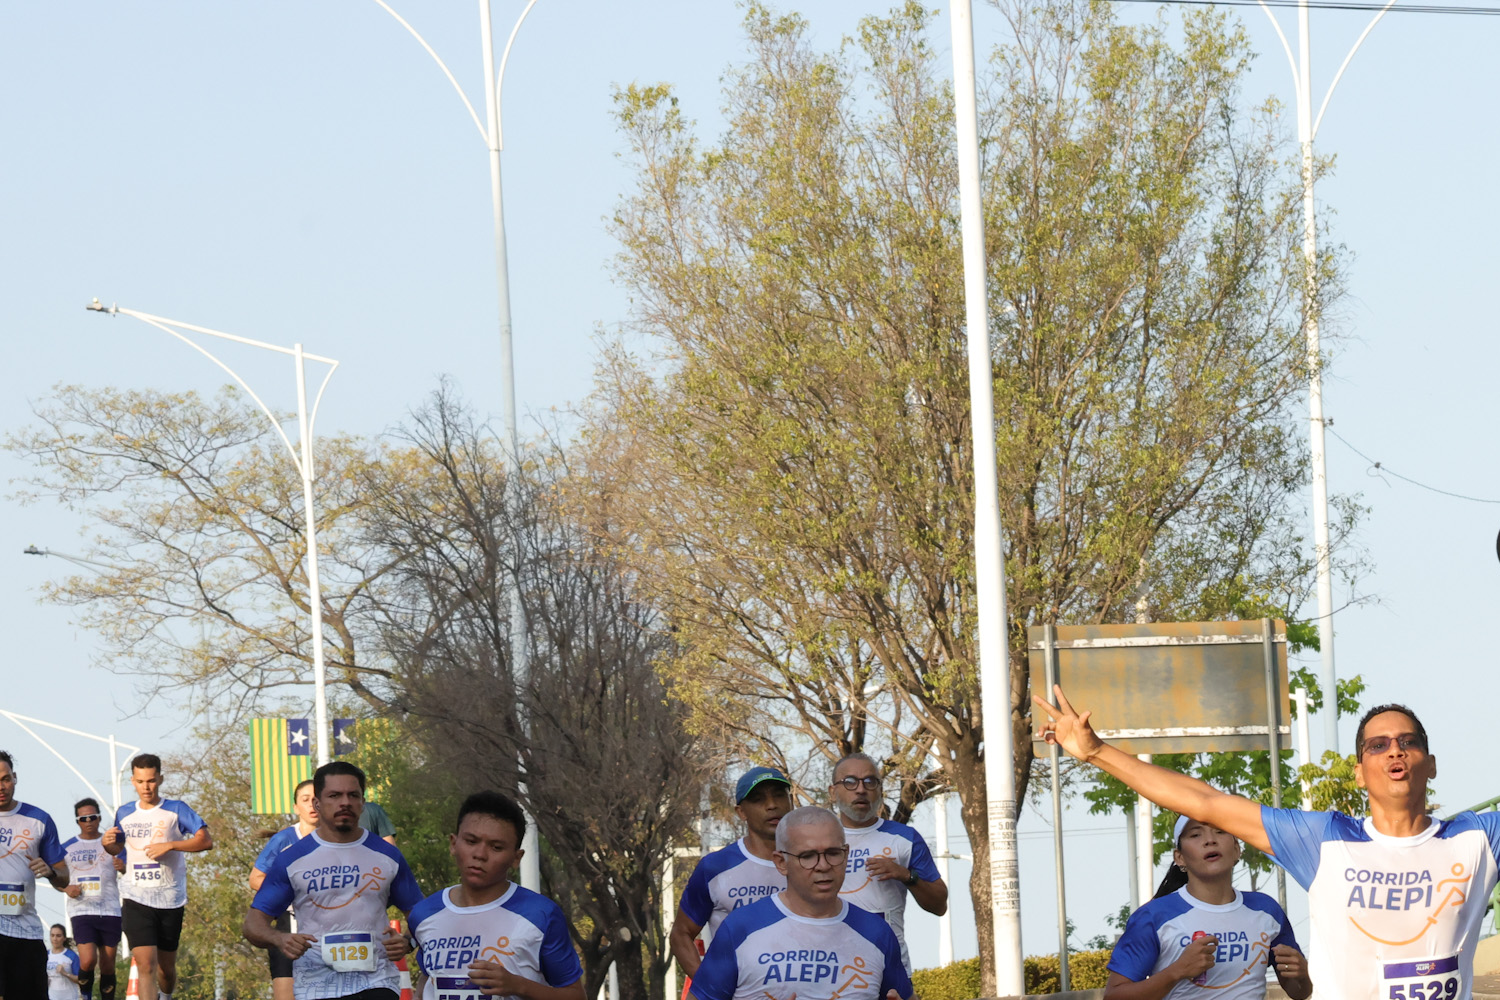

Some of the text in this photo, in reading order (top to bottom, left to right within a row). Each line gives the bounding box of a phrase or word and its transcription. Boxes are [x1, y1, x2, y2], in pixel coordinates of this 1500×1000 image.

[126, 829, 152, 838] ALEPI
[71, 854, 97, 862] ALEPI
[135, 871, 161, 881] 5436
[302, 865, 360, 880] CORRIDA
[1344, 868, 1433, 886] CORRIDA
[82, 882, 100, 891] 038
[307, 874, 360, 894] ALEPI
[0, 893, 26, 906] 100
[1347, 885, 1433, 911] ALEPI
[423, 935, 481, 953] CORRIDA
[330, 946, 369, 961] 1129
[758, 949, 839, 965] CORRIDA
[1215, 943, 1249, 963] EPI
[763, 963, 839, 985] ALEPI
